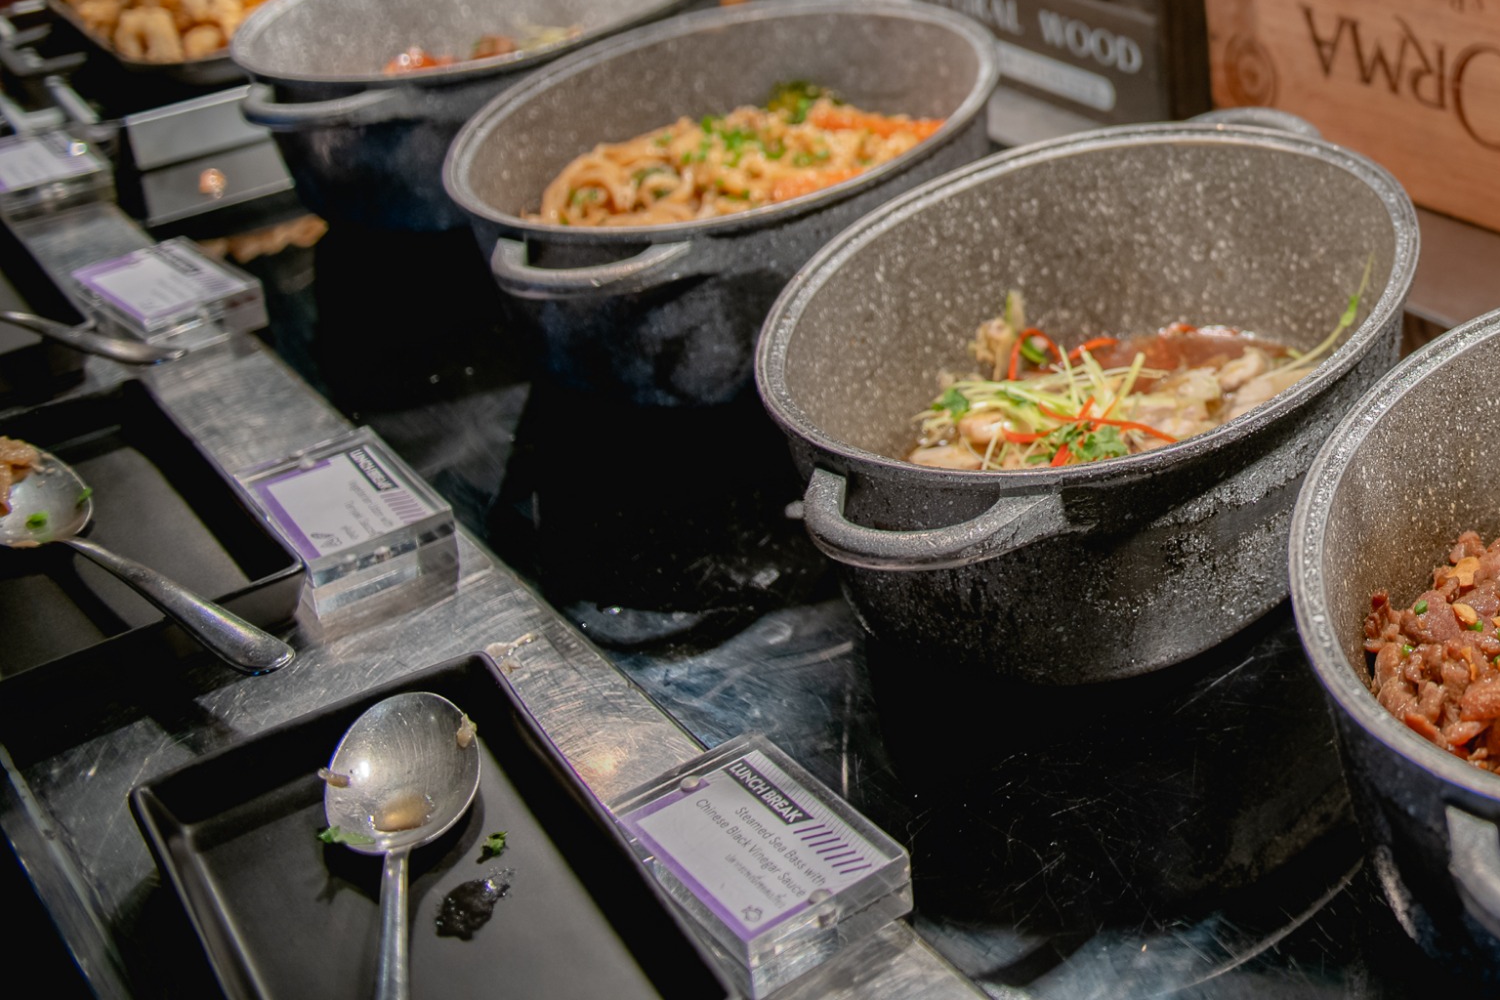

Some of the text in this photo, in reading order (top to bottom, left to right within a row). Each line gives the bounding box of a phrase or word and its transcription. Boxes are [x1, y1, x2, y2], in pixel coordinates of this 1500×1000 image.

[1038, 9, 1142, 74] WOOD
[729, 762, 803, 823] LUNCH BREAK
[695, 798, 730, 830] Chinese
[725, 825, 752, 849] Black
[748, 843, 781, 875] Vinegar
[777, 871, 806, 898] Sauce
[735, 805, 827, 887] Steamed Sea Bass with
